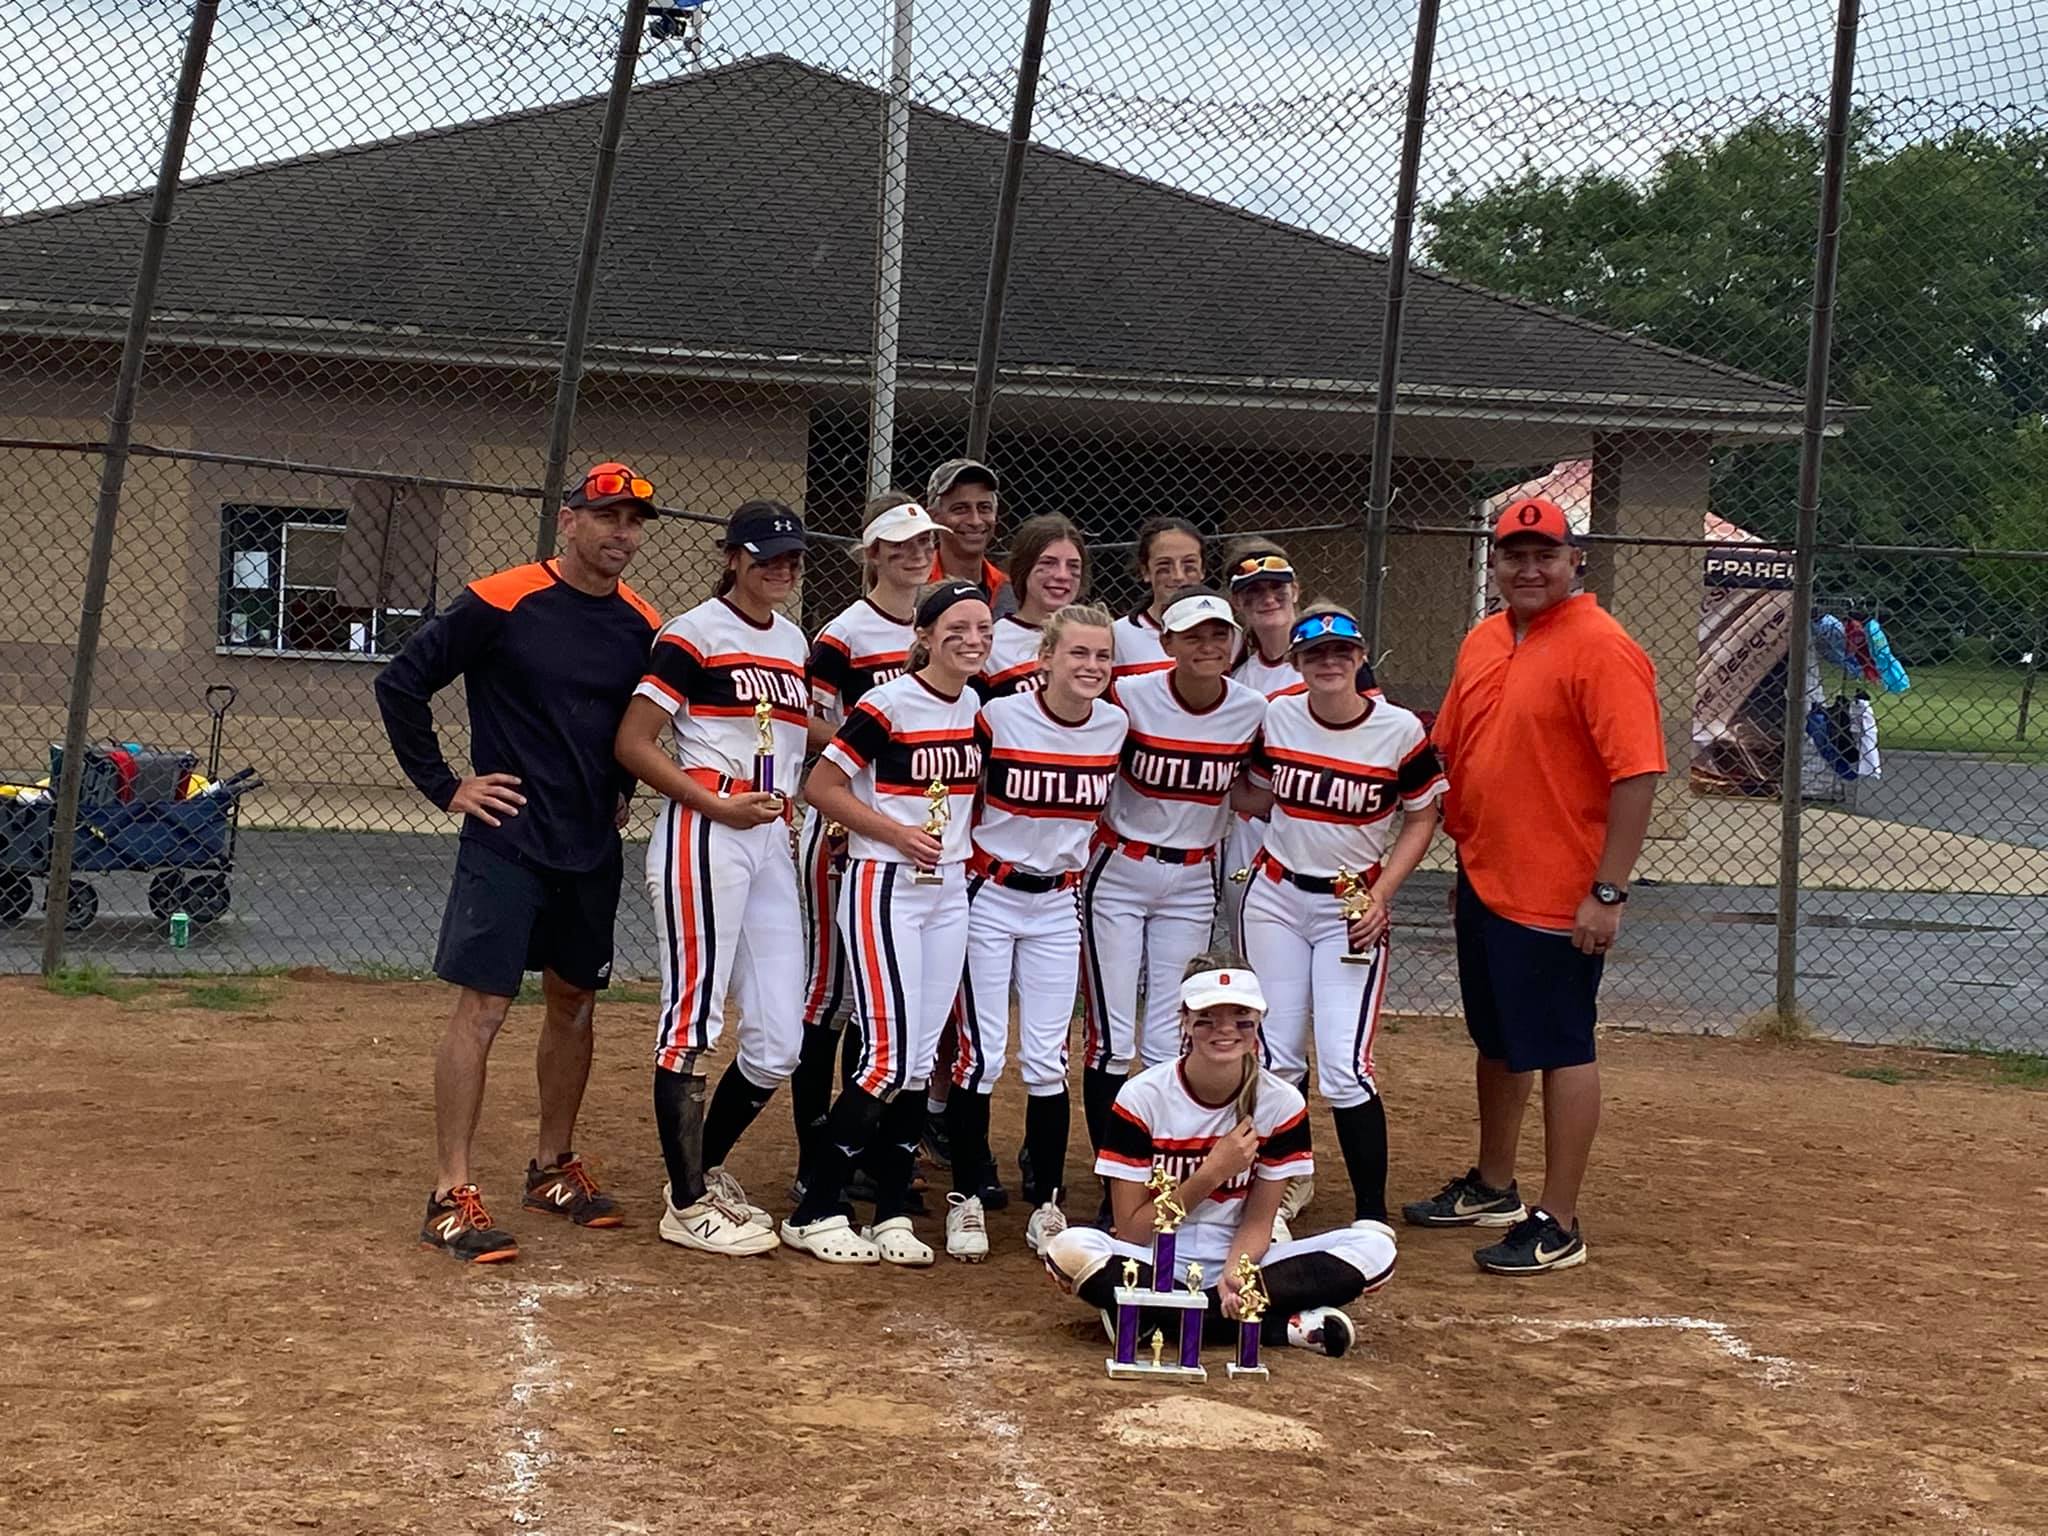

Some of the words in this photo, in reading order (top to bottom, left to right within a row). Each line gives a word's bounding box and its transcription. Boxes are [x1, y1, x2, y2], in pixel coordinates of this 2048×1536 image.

[1516, 504, 1543, 526] O
[1271, 763, 1384, 814] OUTLAWS
[545, 1182, 573, 1207] N
[694, 1217, 721, 1240] N
